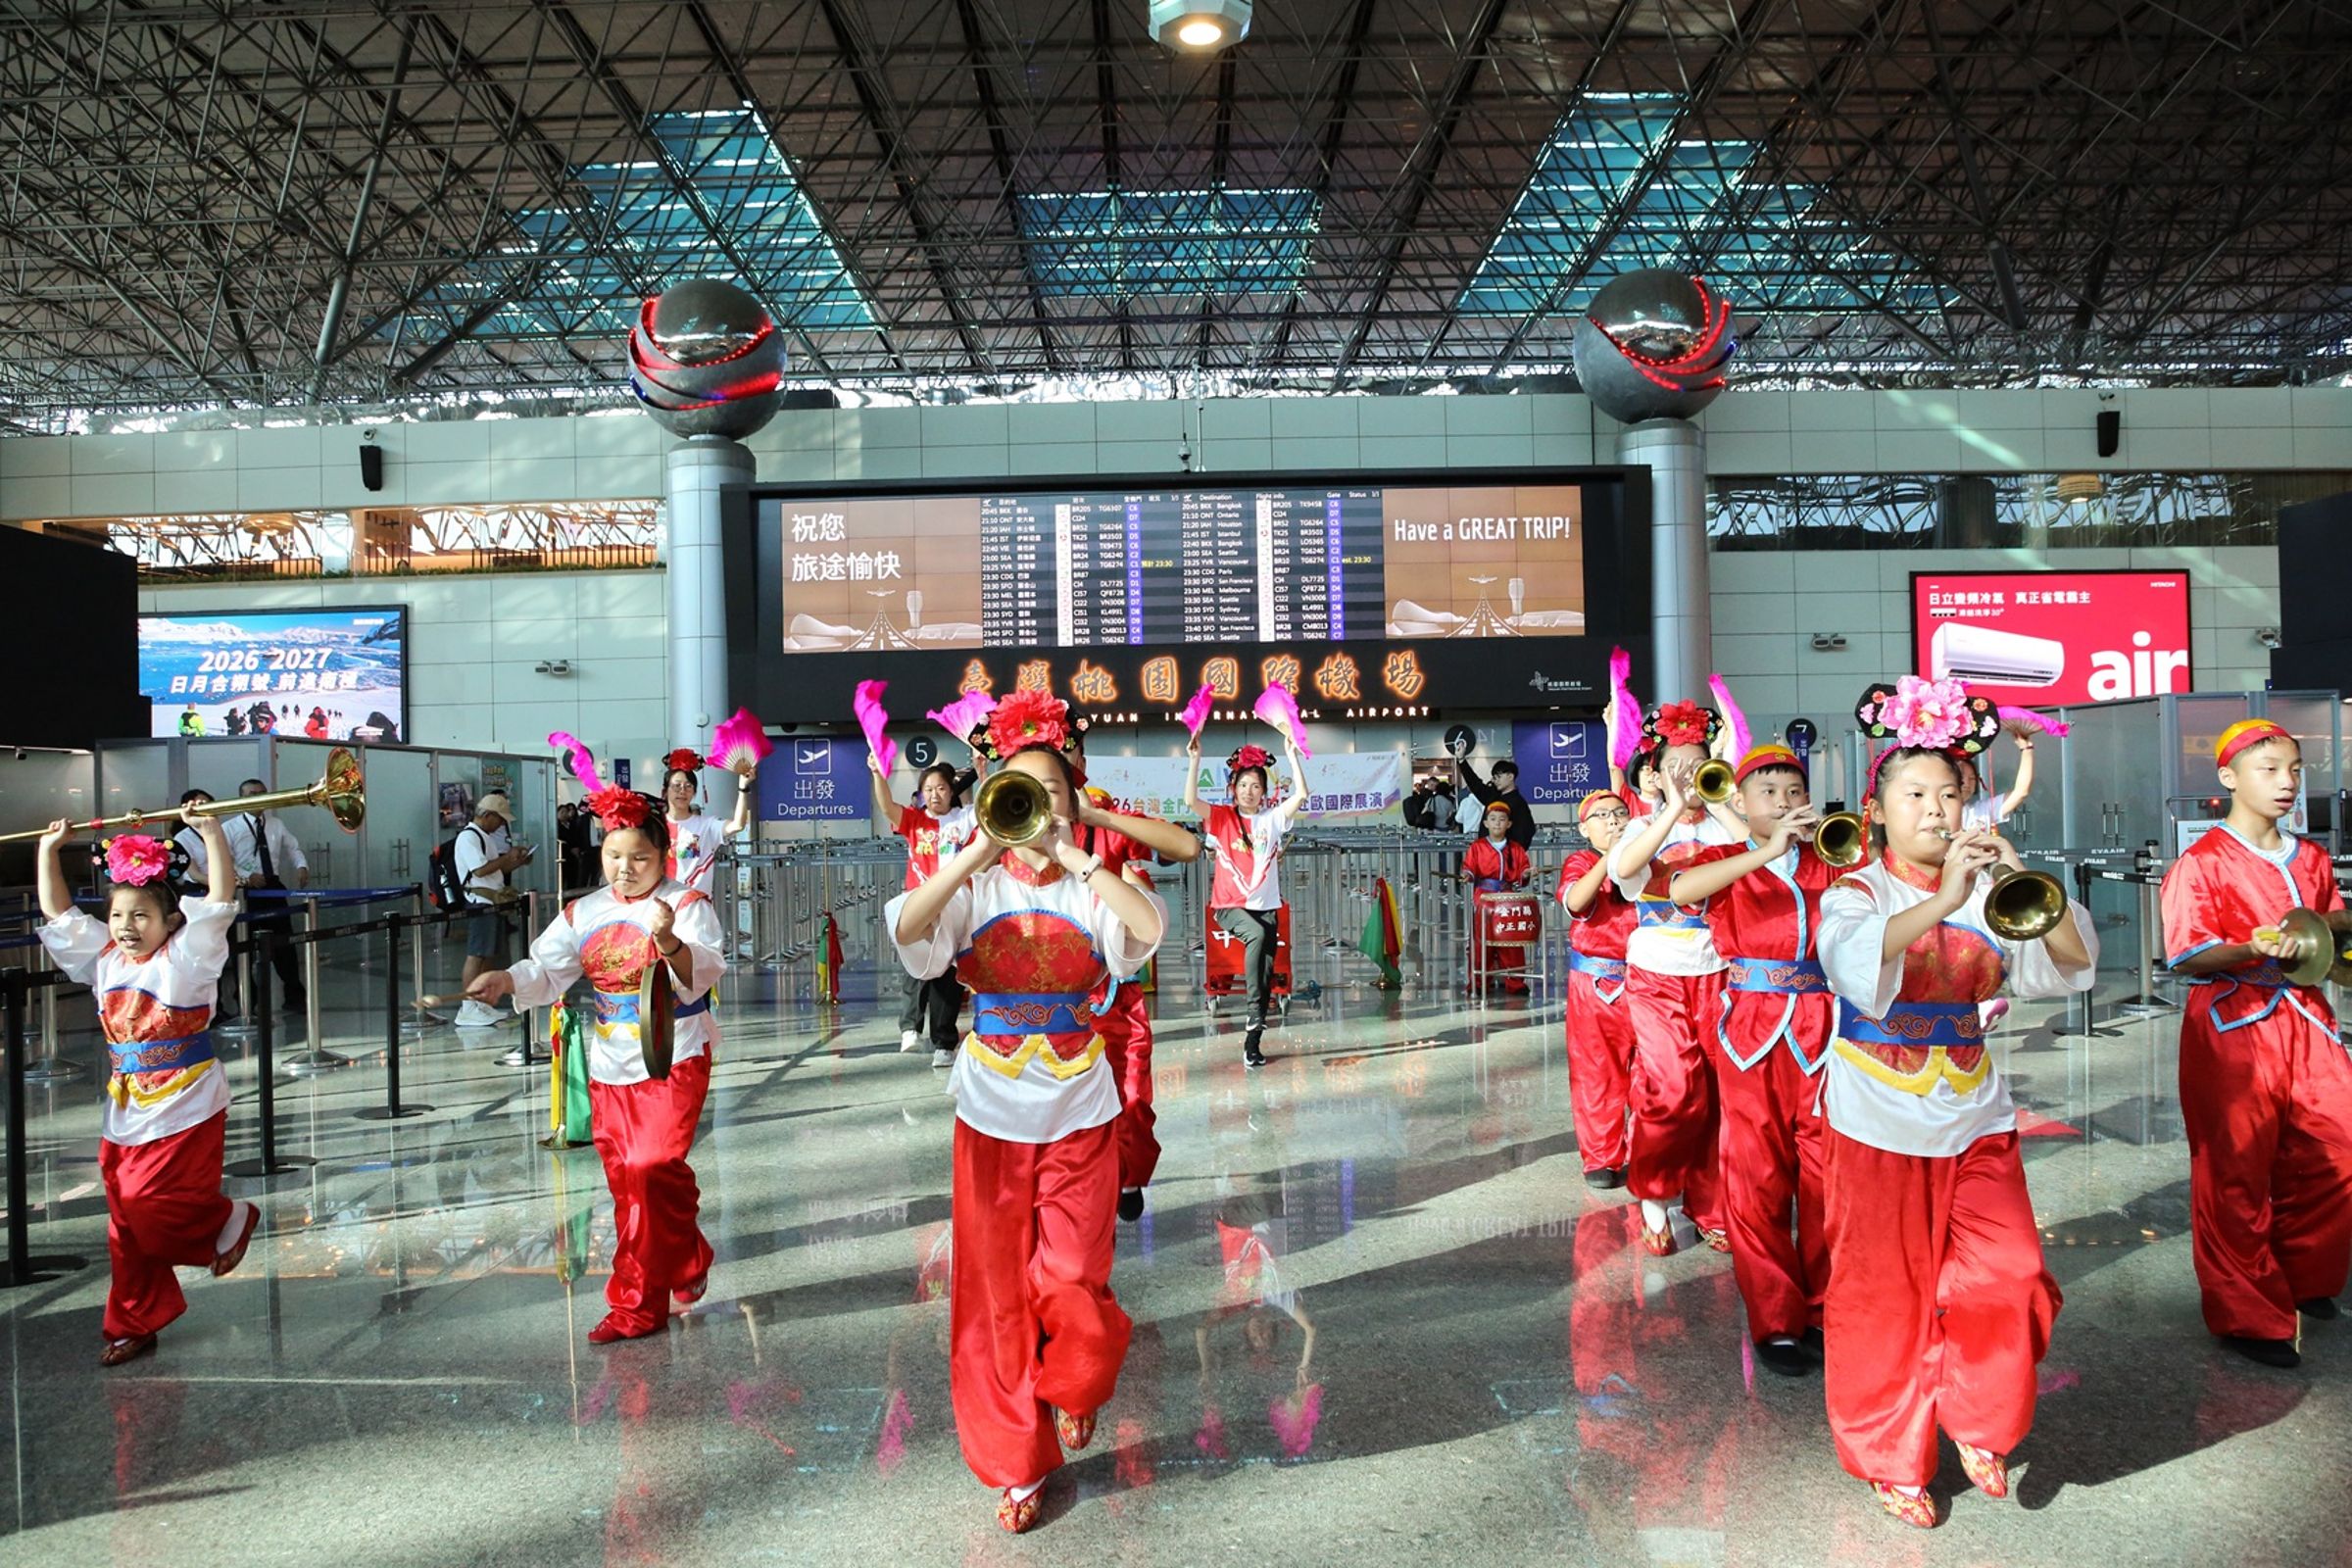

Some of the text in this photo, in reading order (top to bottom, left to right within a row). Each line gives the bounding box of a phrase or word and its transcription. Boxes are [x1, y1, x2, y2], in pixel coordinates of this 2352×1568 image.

[791, 514, 846, 542] 祝您
[1395, 517, 1570, 541] Have a GREAT TRIP!
[792, 551, 901, 582] 旅途愉快
[199, 648, 333, 672] 2026 2027
[2087, 631, 2187, 701] air
[1347, 707, 1429, 718] AIRPORT
[915, 743, 928, 763] 5
[1550, 763, 1591, 783] 出發
[794, 779, 835, 799] 出發
[778, 803, 854, 818] Departures
